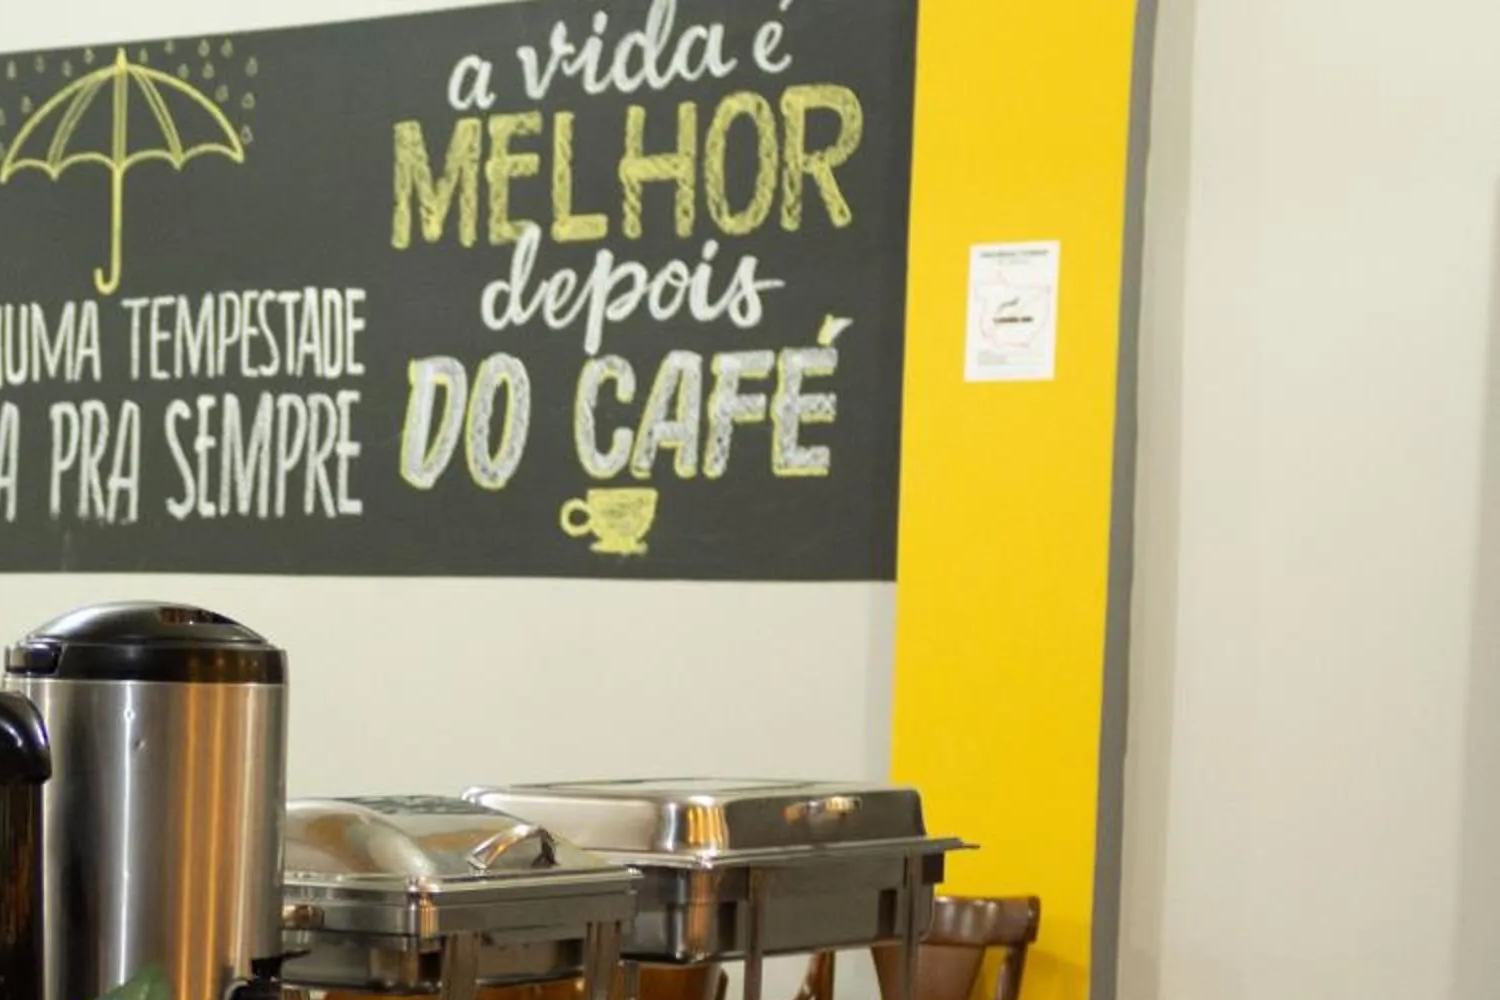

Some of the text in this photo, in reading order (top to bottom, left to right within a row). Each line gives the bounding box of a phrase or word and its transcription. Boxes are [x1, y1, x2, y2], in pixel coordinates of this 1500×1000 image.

[448, 0, 793, 110] a vida é
[391, 83, 864, 249] MELHOR
[121, 285, 368, 382] TEMPESTADE
[480, 222, 786, 356] depois
[49, 399, 142, 524] PRA
[164, 389, 364, 521] SEMPRE
[399, 314, 854, 489] DO CAFÉ
